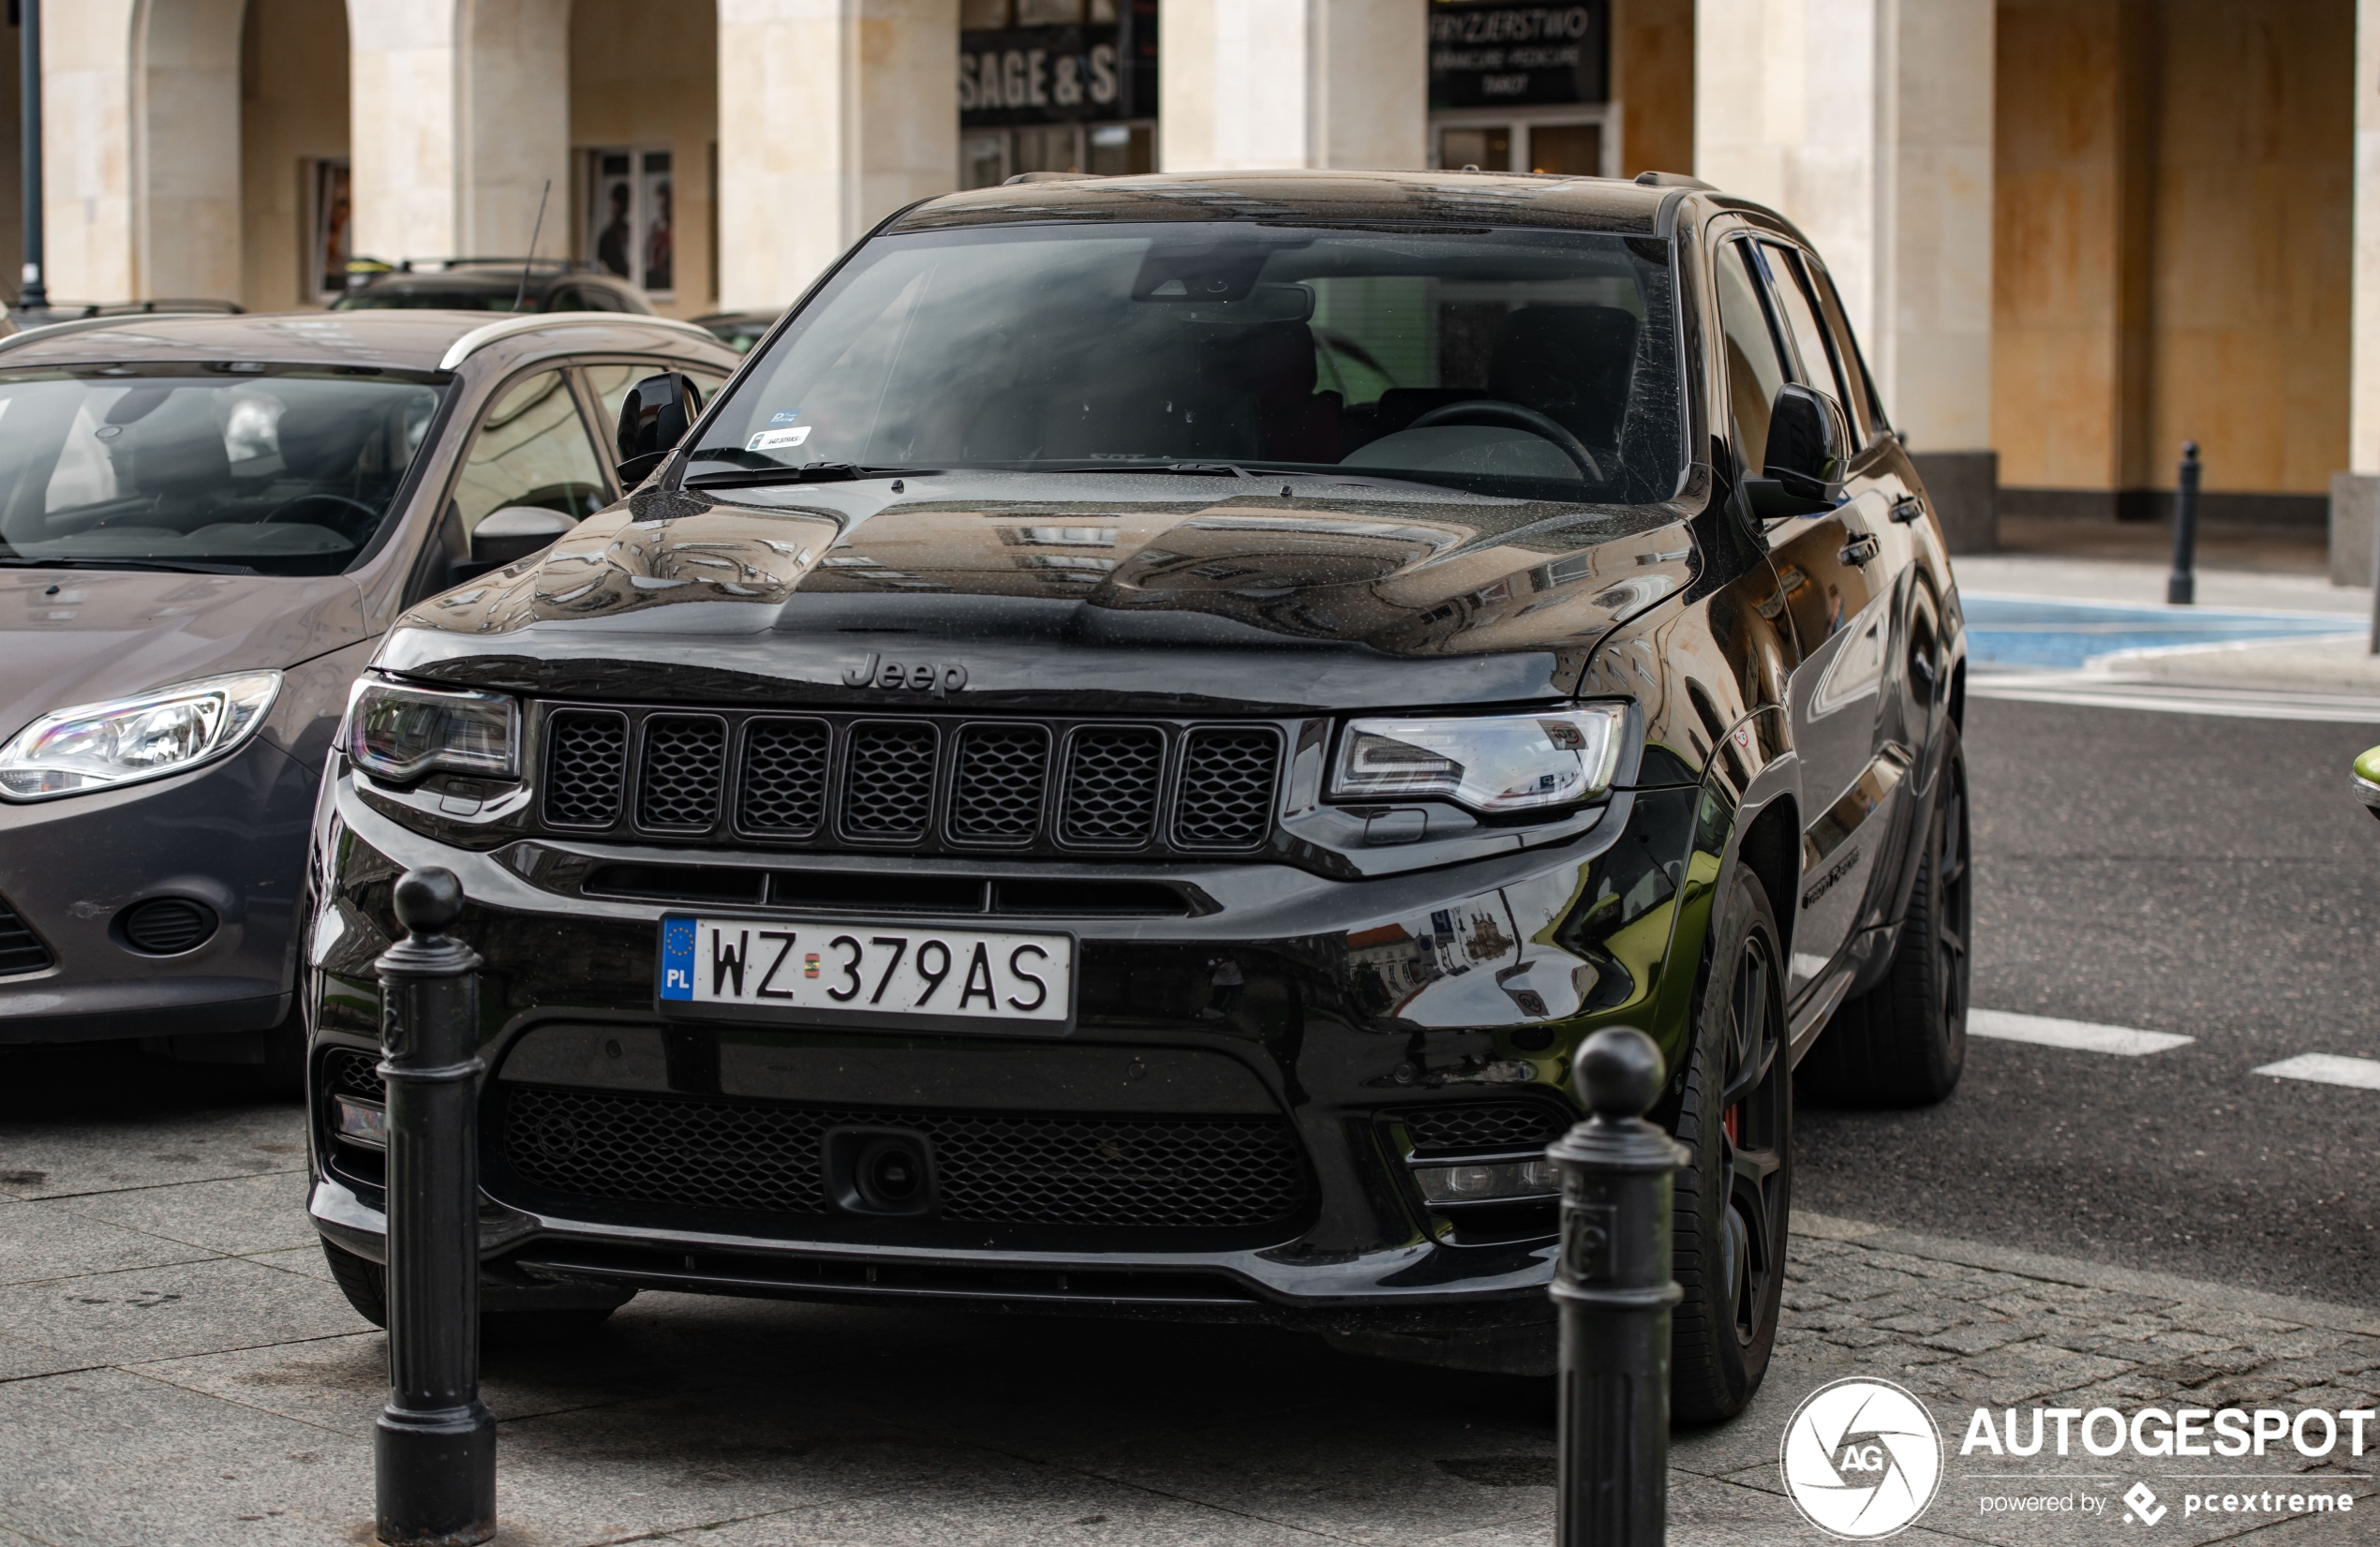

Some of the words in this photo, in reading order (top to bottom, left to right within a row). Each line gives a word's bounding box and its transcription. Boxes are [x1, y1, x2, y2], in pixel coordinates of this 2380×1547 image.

[959, 49, 1048, 111] SAGE
[1053, 54, 1084, 105] &
[842, 653, 968, 700] Jeep
[666, 969, 690, 989] PL
[711, 928, 796, 1000] WZ
[826, 934, 1049, 1012] 379AS
